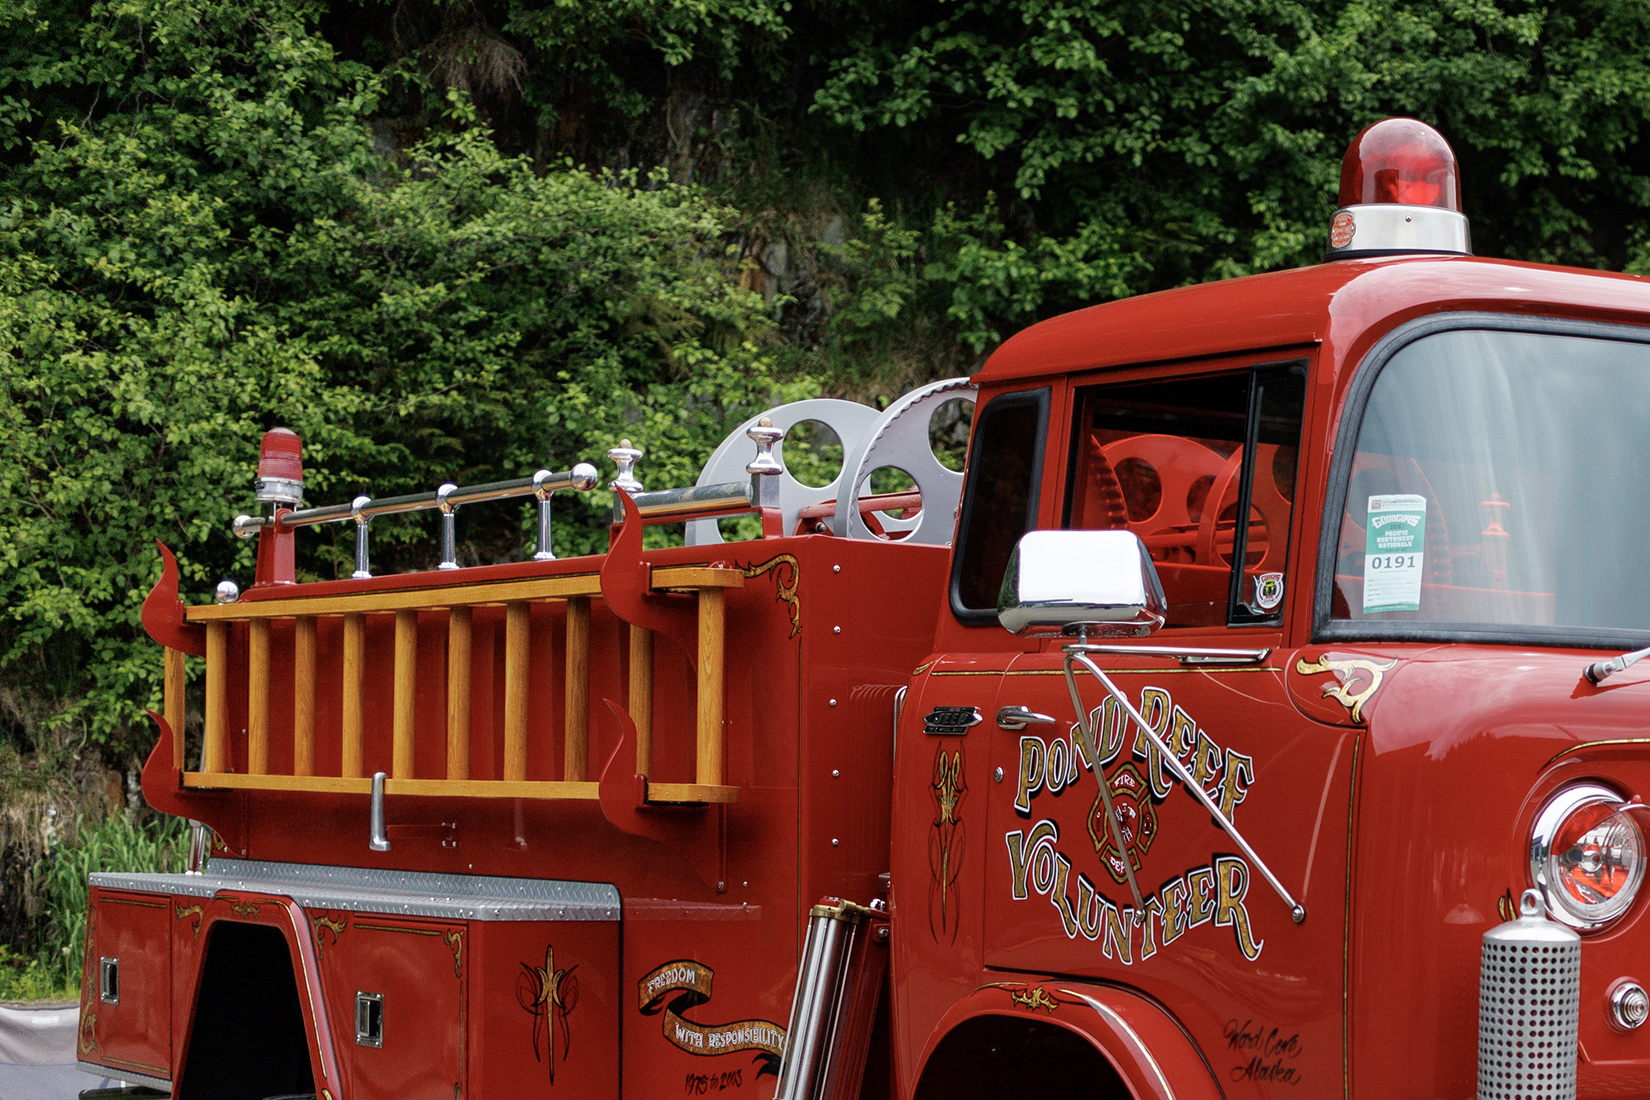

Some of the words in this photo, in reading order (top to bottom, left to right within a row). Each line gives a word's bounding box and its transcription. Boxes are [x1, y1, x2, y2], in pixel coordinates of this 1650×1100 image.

[1371, 514, 1421, 529] GOODGUYS
[1377, 535, 1414, 543] NORTHWEST
[1371, 556, 1415, 569] 0191
[933, 712, 969, 725] JEEP
[1014, 690, 1128, 812] POND
[1133, 686, 1256, 826] REEF
[1114, 774, 1136, 787] FIRE
[1110, 856, 1126, 873] DEP
[1005, 819, 1264, 965] VOLUNTEER
[647, 968, 696, 994] FREEDOM
[675, 1022, 704, 1048] WITH
[708, 1027, 785, 1050] RESPONSIBILITY
[1230, 1057, 1302, 1086] Alaska
